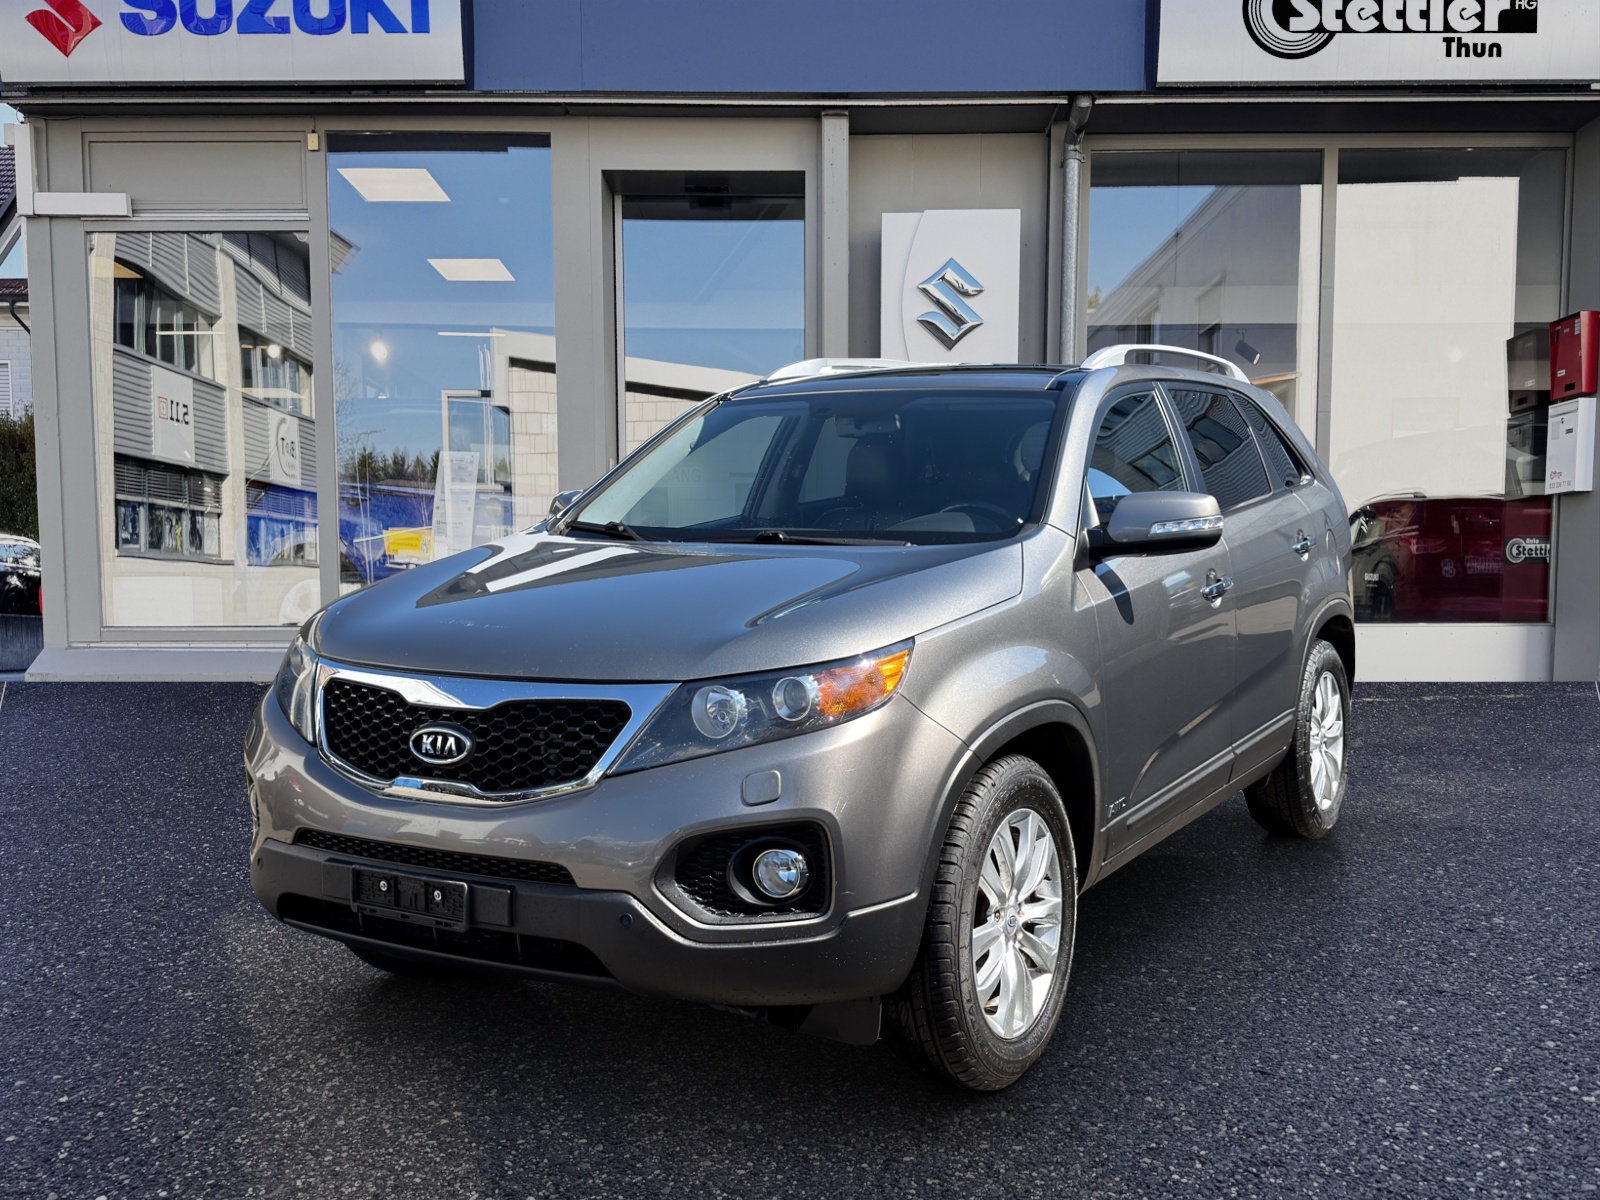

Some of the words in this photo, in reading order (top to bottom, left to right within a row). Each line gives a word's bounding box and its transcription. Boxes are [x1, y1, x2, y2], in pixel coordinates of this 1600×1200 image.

[119, 0, 431, 35] SUZUKI
[1288, 0, 1511, 32] Stettler
[1442, 37, 1502, 58] Thun
[422, 735, 457, 755] KIA
